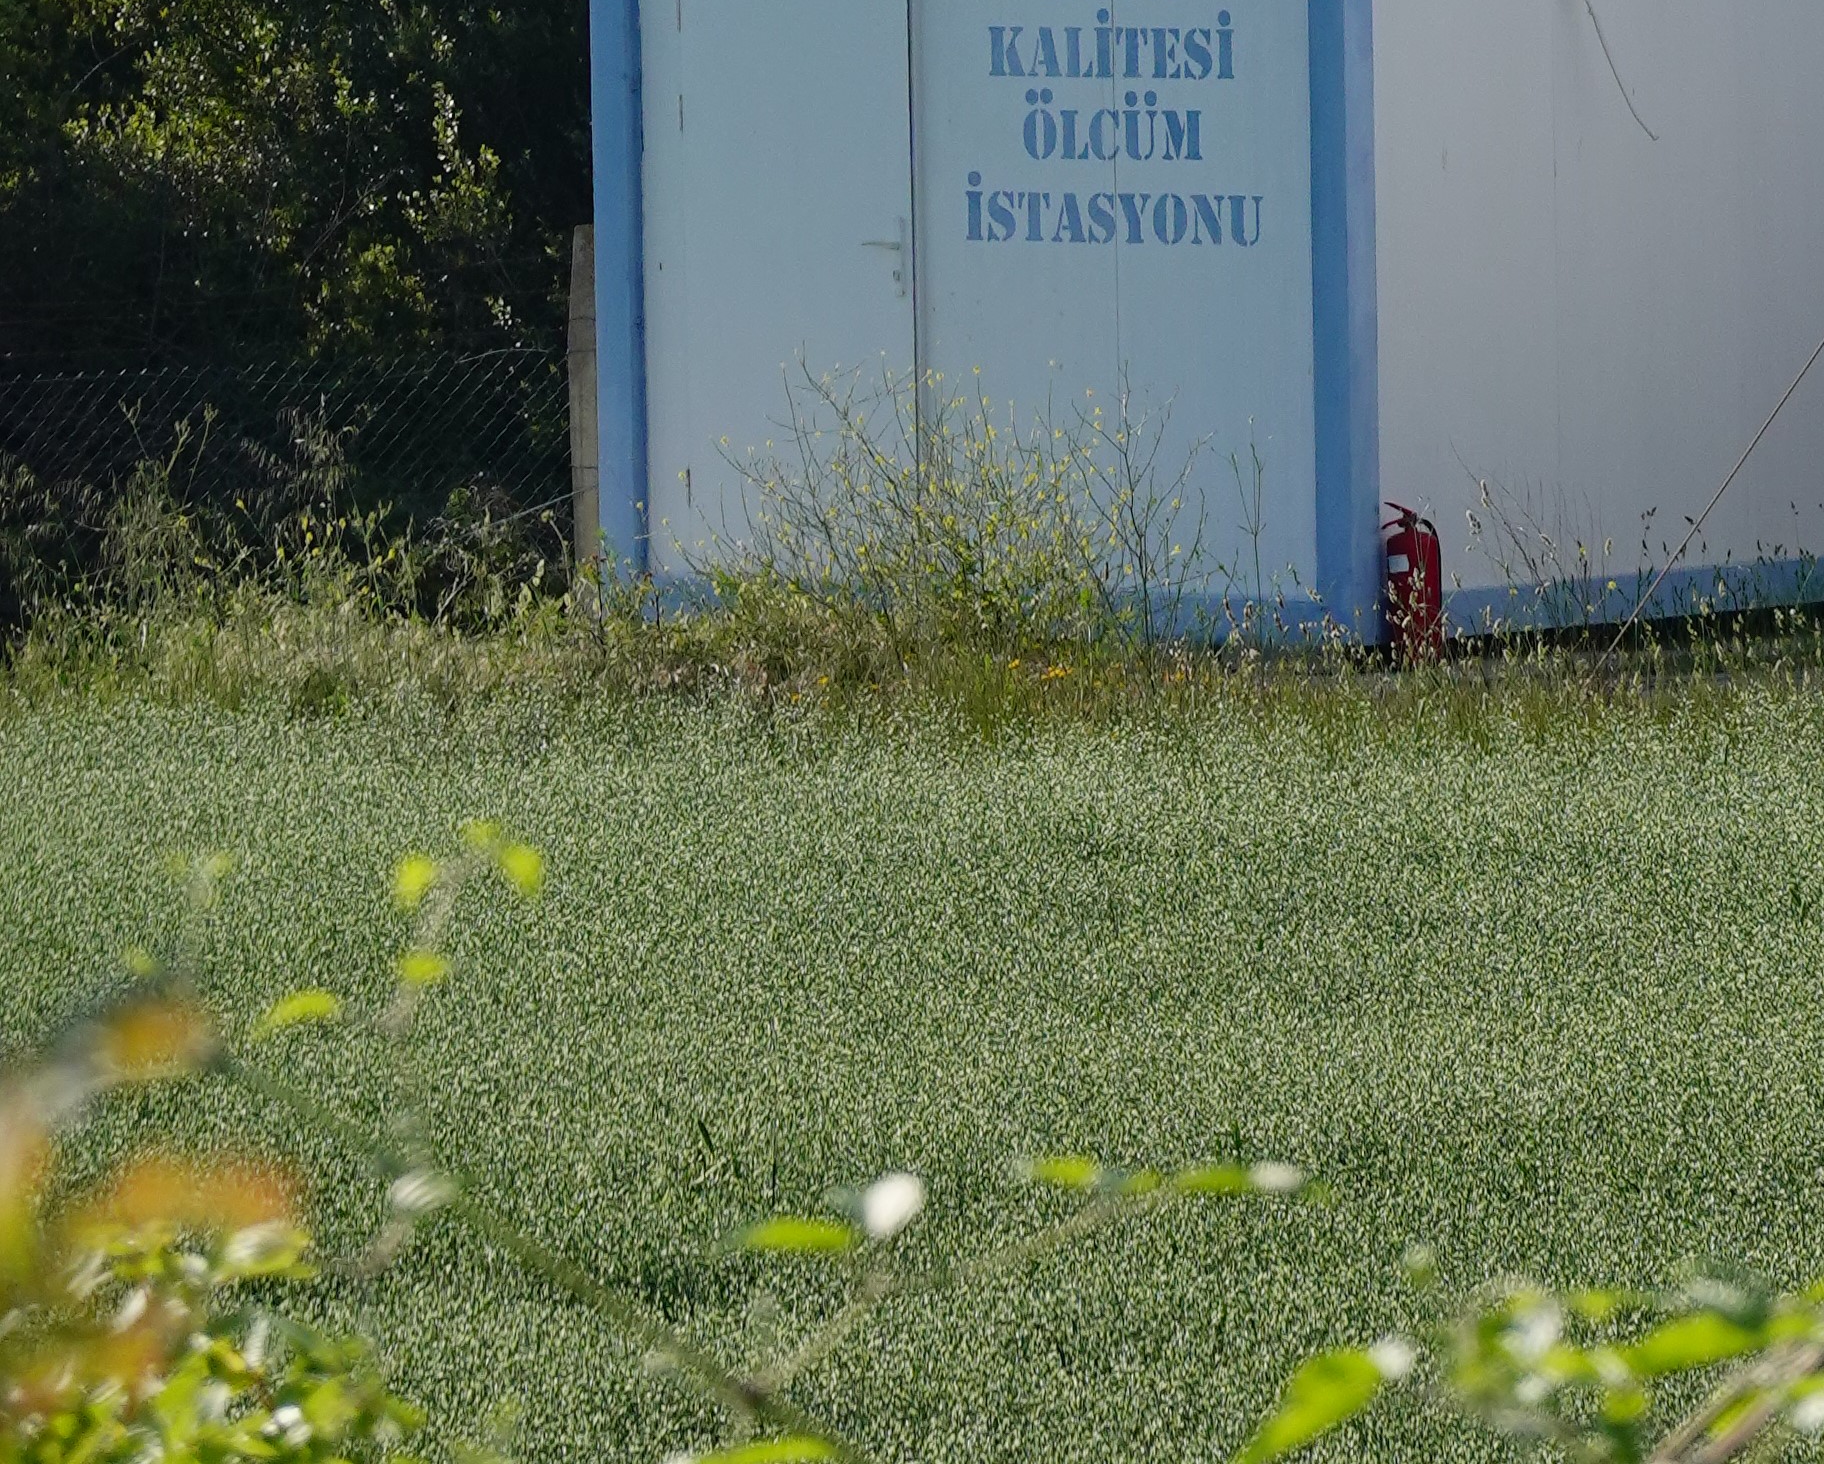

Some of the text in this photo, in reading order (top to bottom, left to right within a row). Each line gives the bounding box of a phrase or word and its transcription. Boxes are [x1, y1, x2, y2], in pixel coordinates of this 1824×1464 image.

[988, 8, 1235, 80] KALİTESİ
[1023, 88, 1203, 161] ÖLCÜM
[965, 171, 1264, 247] İSTASYONU
